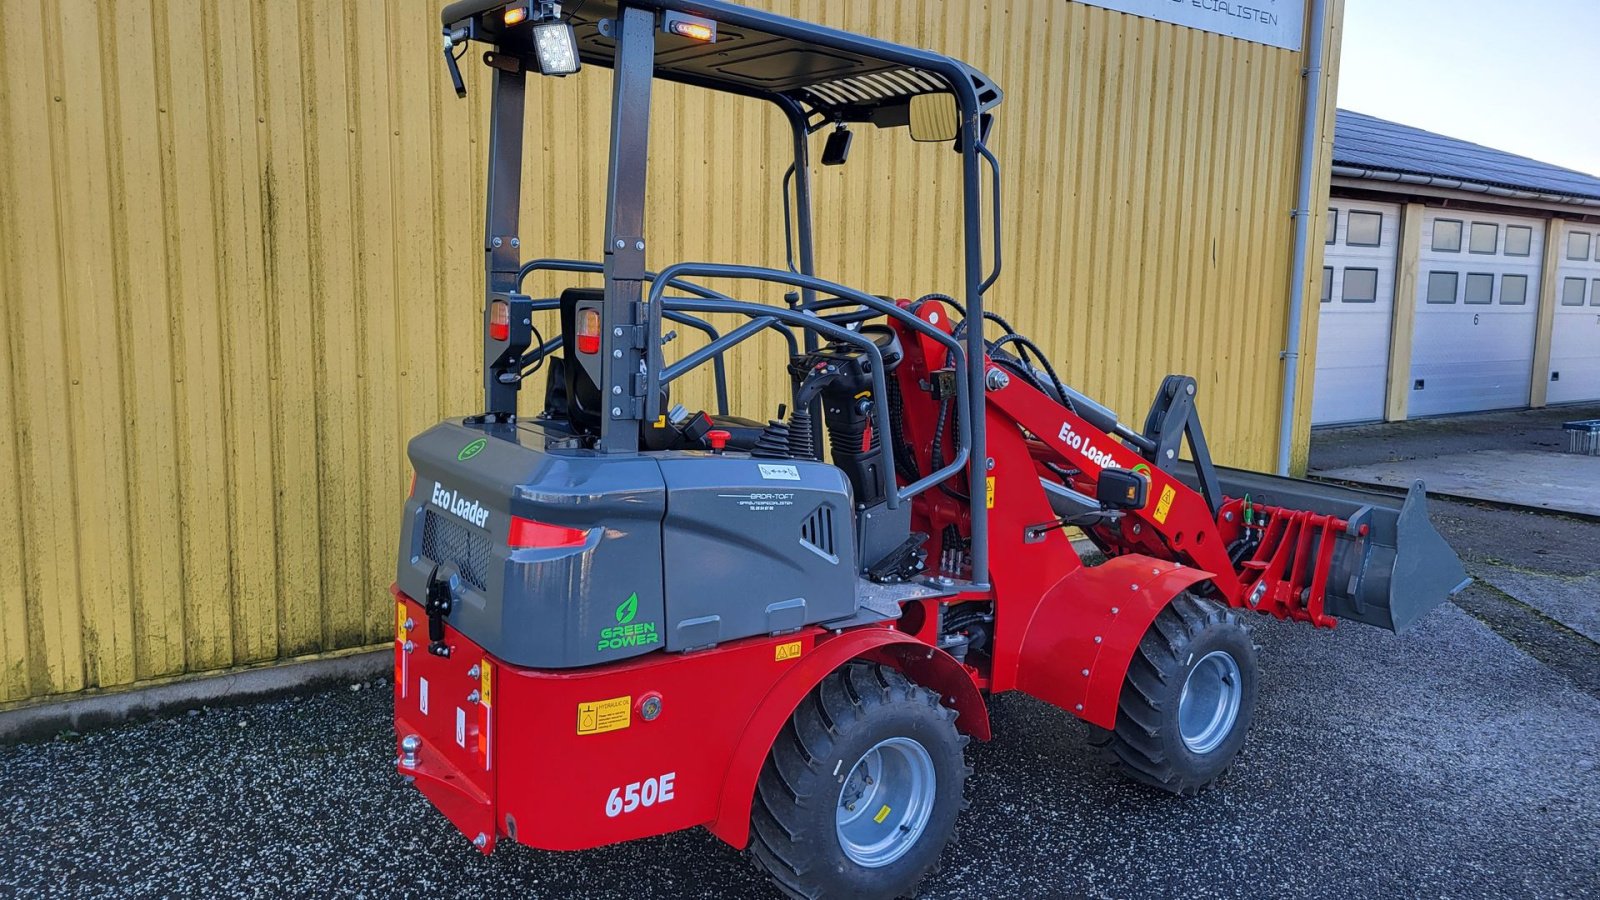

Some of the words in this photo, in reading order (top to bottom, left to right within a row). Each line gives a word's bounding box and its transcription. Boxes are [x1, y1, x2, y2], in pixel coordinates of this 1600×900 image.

[1172, 0, 1278, 26] ECIALISTEN
[1473, 313, 1479, 326] 6
[1058, 421, 1081, 450] Eco
[431, 480, 451, 510] Eco
[450, 490, 490, 529] Loader
[597, 632, 659, 651] POWER
[600, 622, 655, 639] GREEN
[605, 771, 676, 817] 650E
